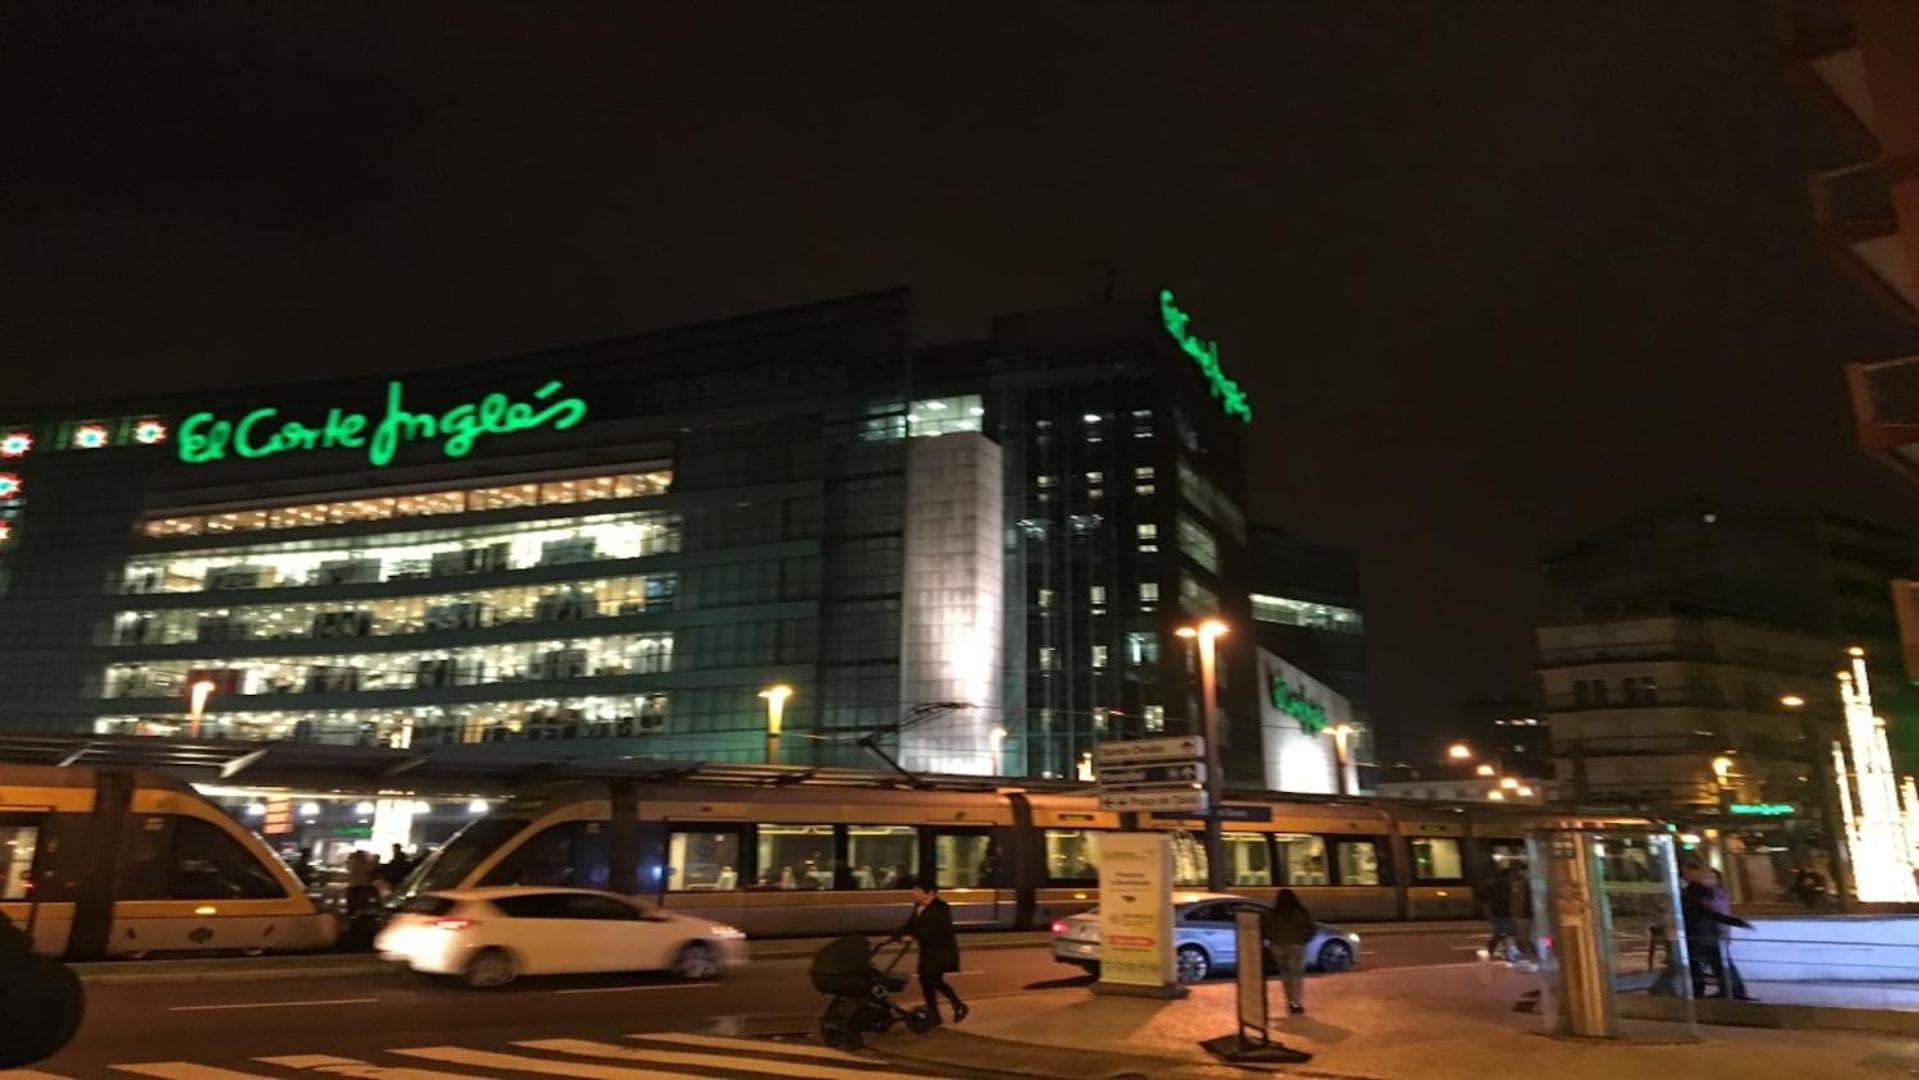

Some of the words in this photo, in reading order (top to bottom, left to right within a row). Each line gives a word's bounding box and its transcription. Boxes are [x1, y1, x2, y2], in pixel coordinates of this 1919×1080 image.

[177, 412, 231, 463] El
[233, 408, 367, 458] Corte
[368, 381, 587, 467] Inglés
